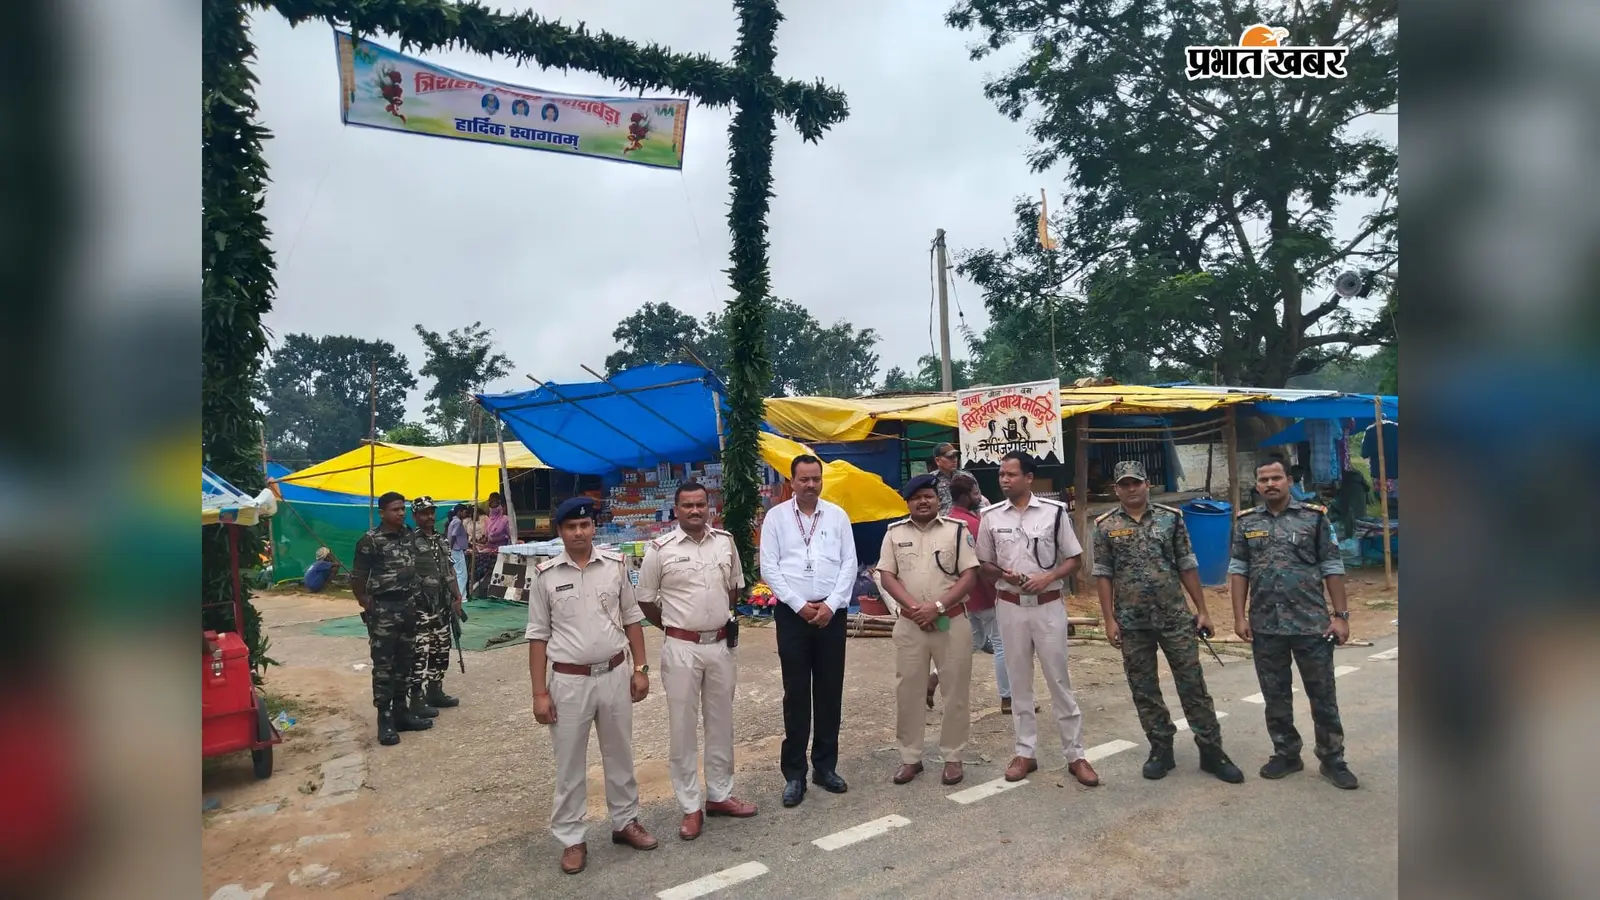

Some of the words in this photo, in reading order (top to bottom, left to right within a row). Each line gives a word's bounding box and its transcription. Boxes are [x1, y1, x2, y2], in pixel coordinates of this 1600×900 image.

[454, 117, 506, 135] हार्दिक
[509, 125, 579, 150] स्वागतम्
[961, 393, 983, 407] बाबा
